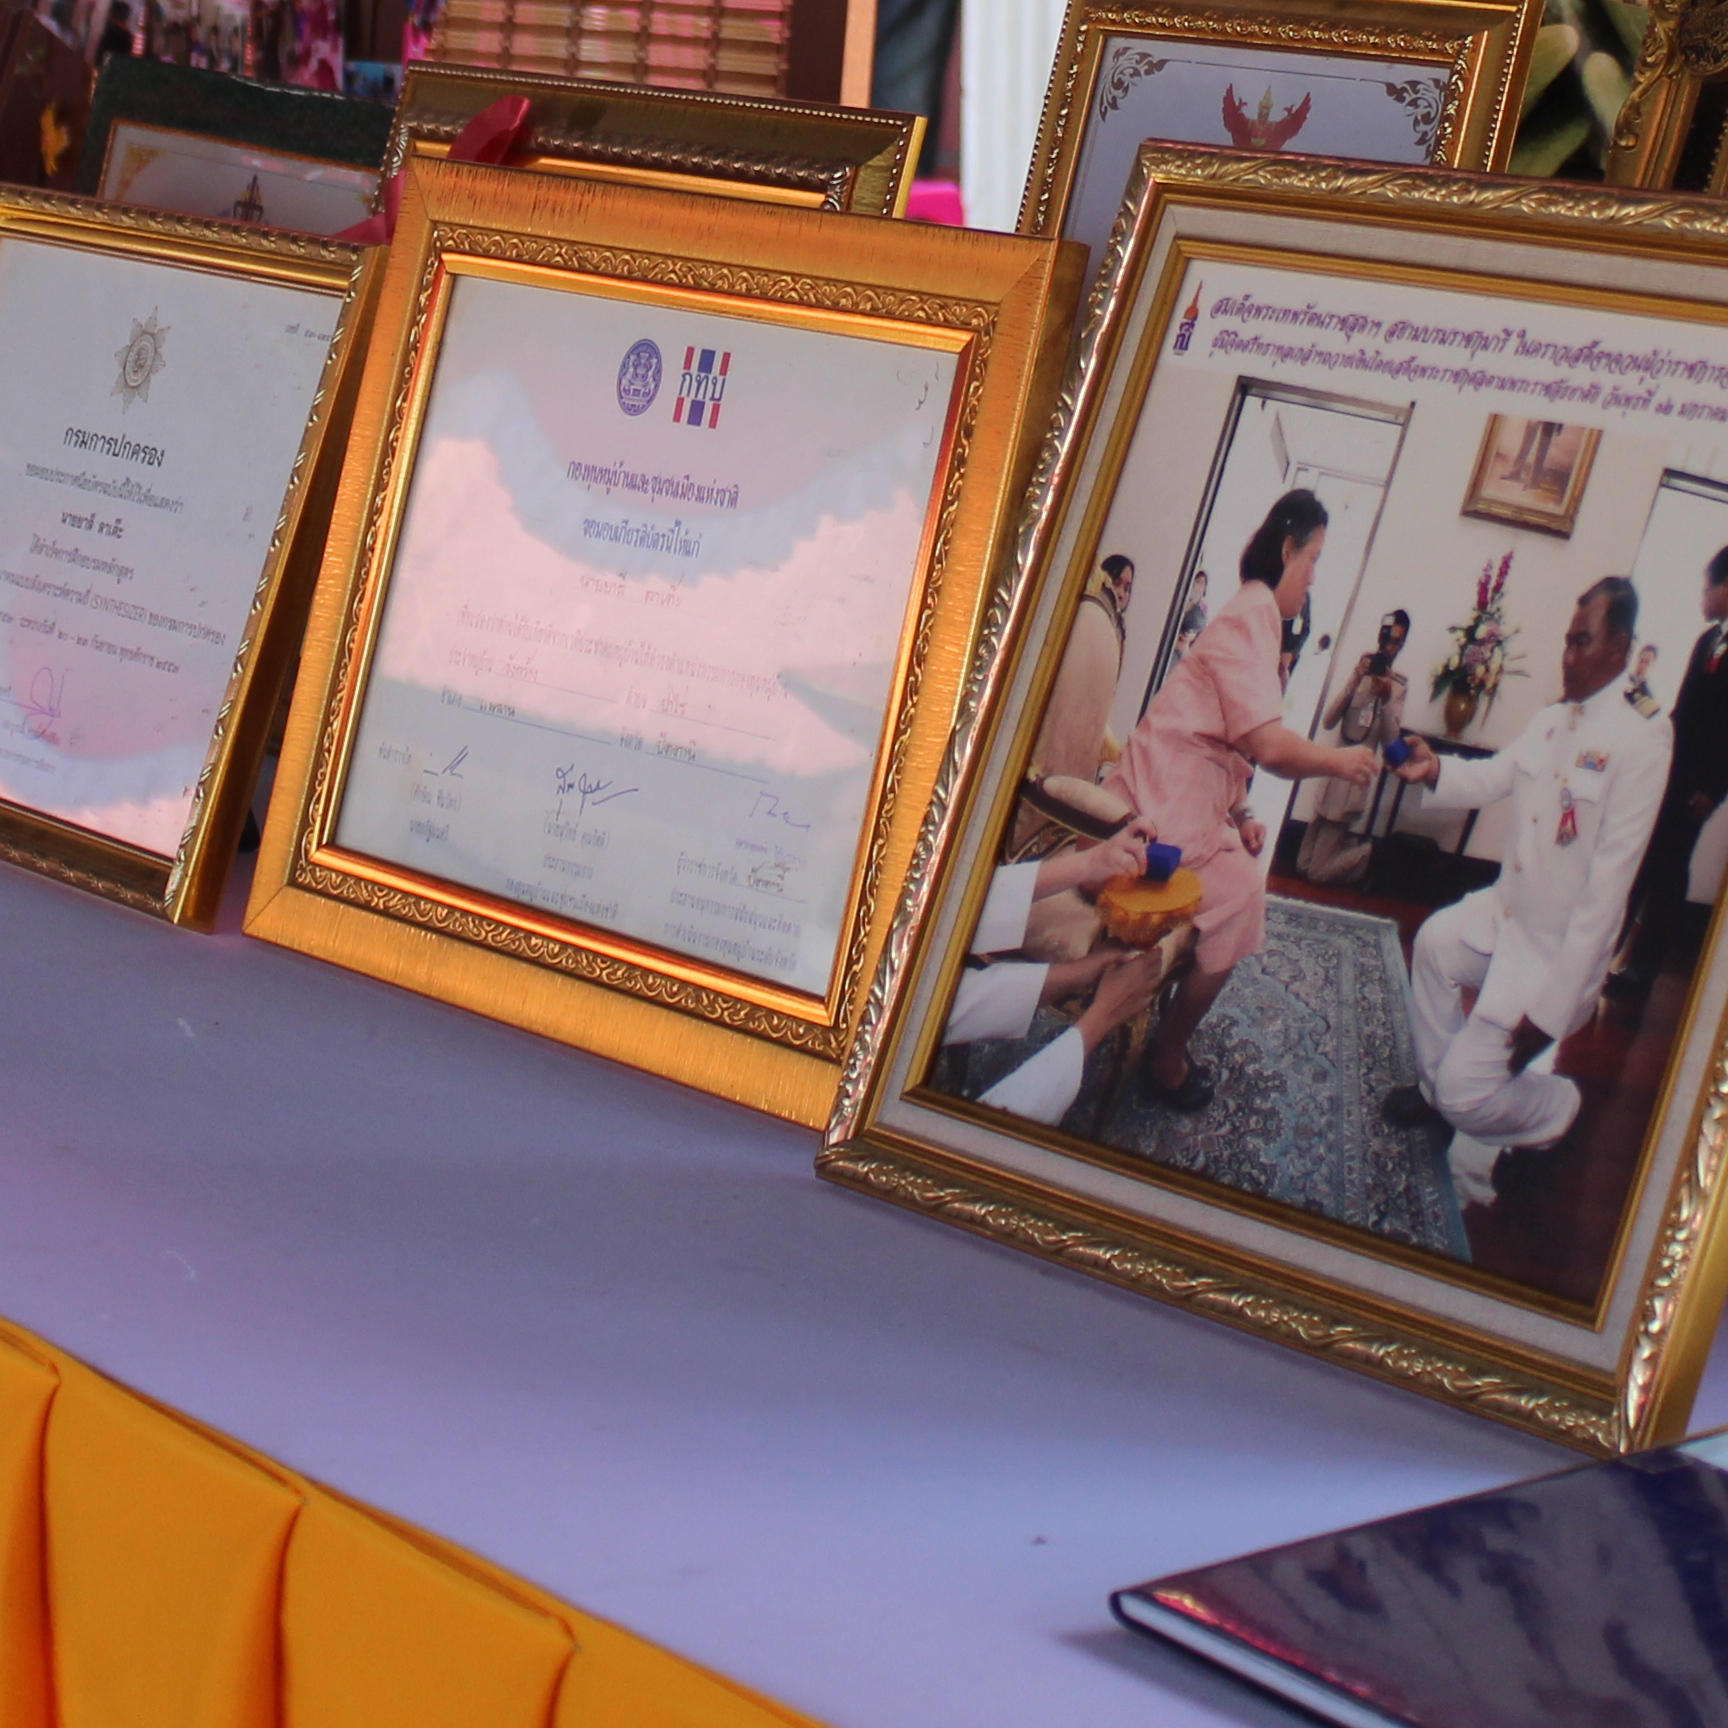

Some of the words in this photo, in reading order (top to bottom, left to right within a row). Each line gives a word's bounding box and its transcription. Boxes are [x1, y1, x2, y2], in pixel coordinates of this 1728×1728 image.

[678, 371, 727, 402] กทบ
[63, 427, 166, 467] กรมการปกครอง
